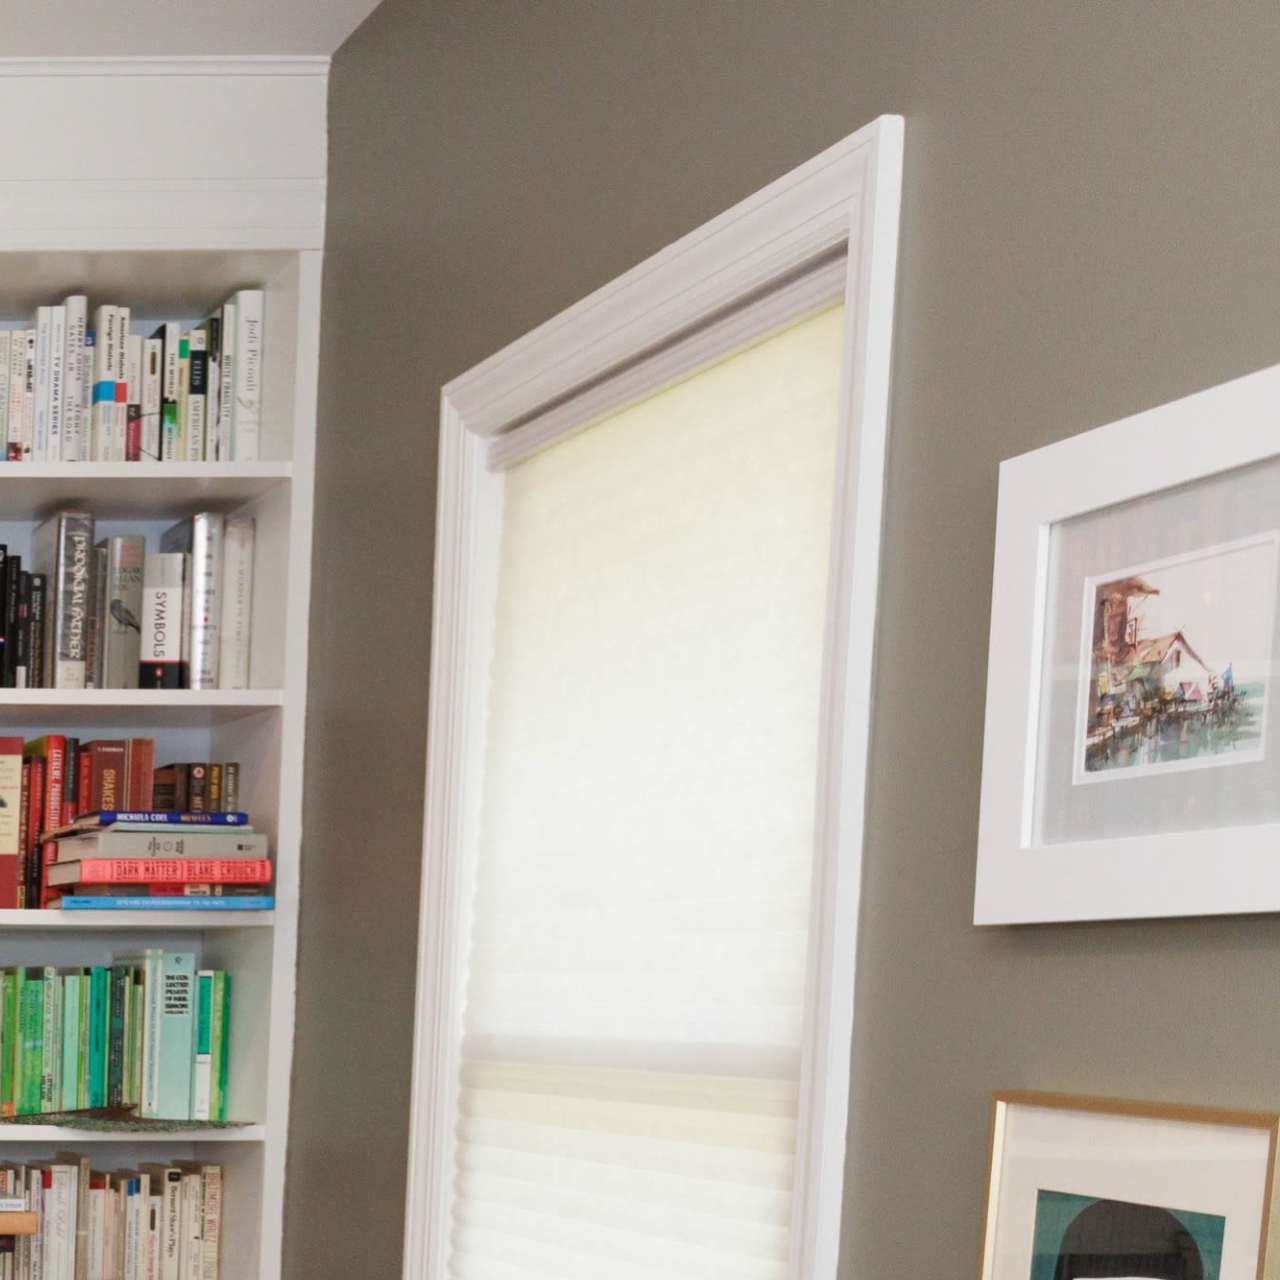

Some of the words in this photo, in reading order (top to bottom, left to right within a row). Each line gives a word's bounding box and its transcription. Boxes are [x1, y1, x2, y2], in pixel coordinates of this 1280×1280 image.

[192, 360, 203, 386] ELLIS
[223, 355, 233, 379] WHITE
[51, 369, 60, 403] DRAMA
[167, 370, 176, 396] WORLD
[51, 405, 59, 436] SERIES
[166, 427, 174, 460] WITHOUT
[153, 591, 167, 659] SYMBOLS
[51, 750, 63, 781] EXTREME
[144, 862, 179, 878] MATTER
